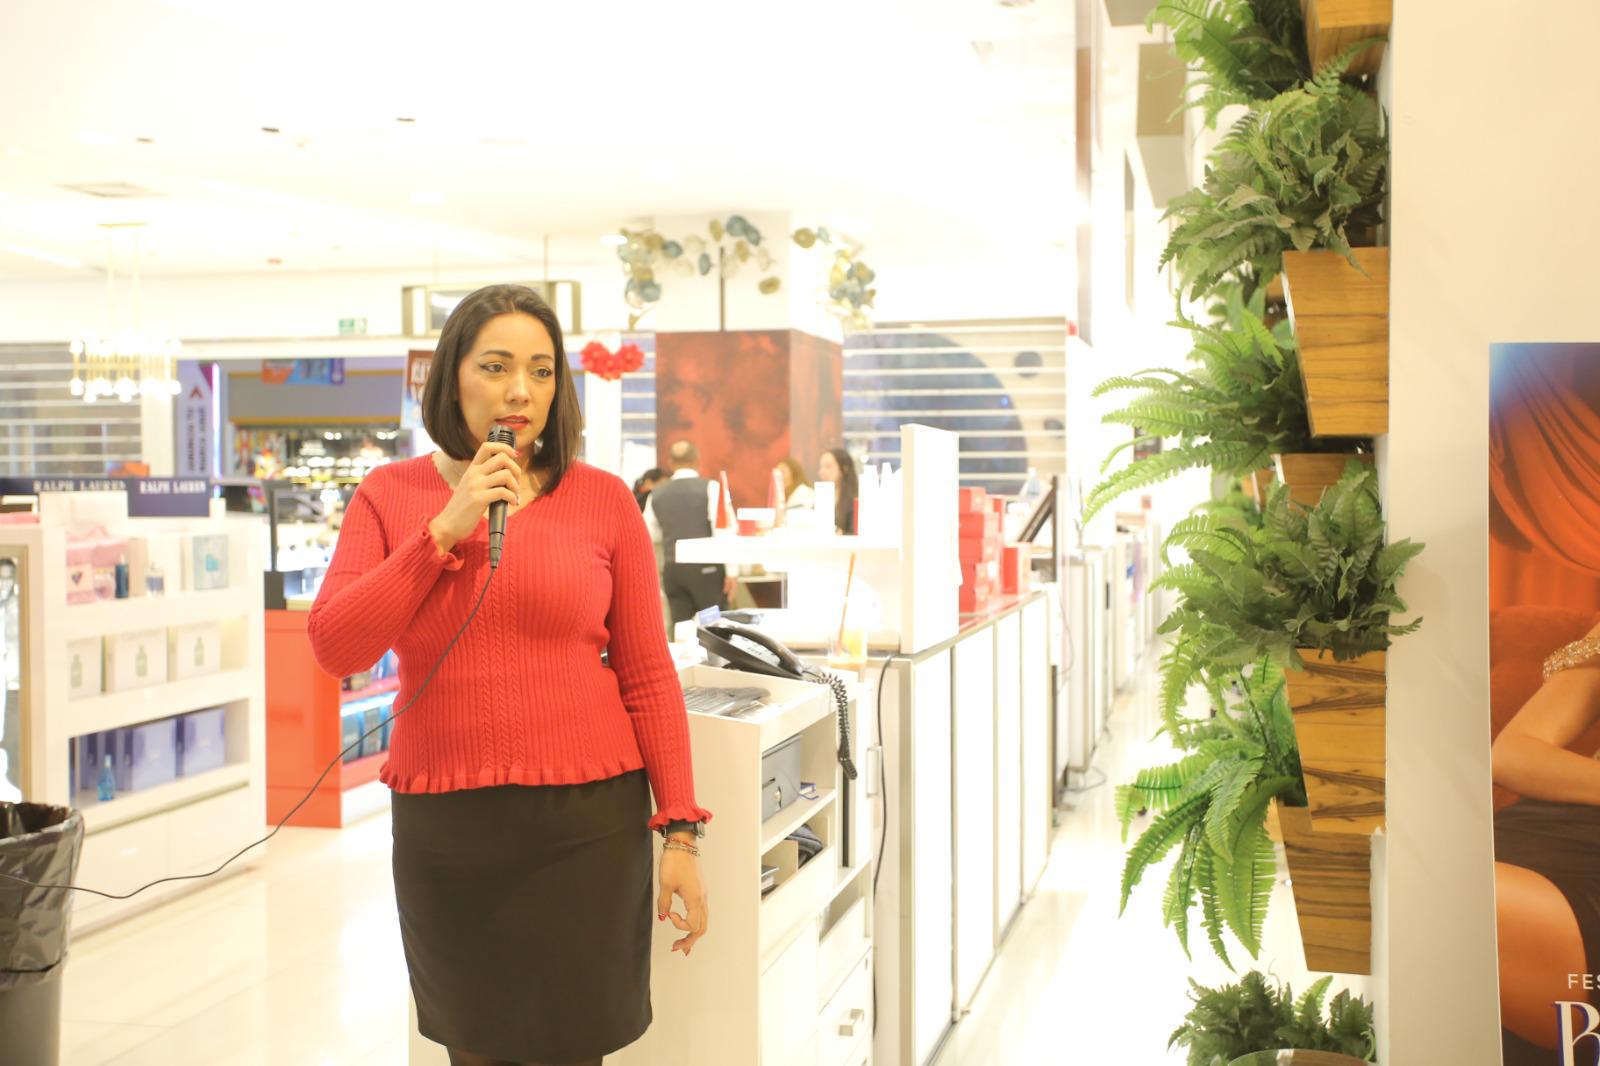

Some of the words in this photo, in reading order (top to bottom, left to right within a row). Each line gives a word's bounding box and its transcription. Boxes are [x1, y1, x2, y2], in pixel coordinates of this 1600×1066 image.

[33, 480, 75, 492] RALPH
[80, 480, 126, 491] LAUREN
[139, 481, 170, 494] RALPH
[173, 481, 206, 494] LAUREN
